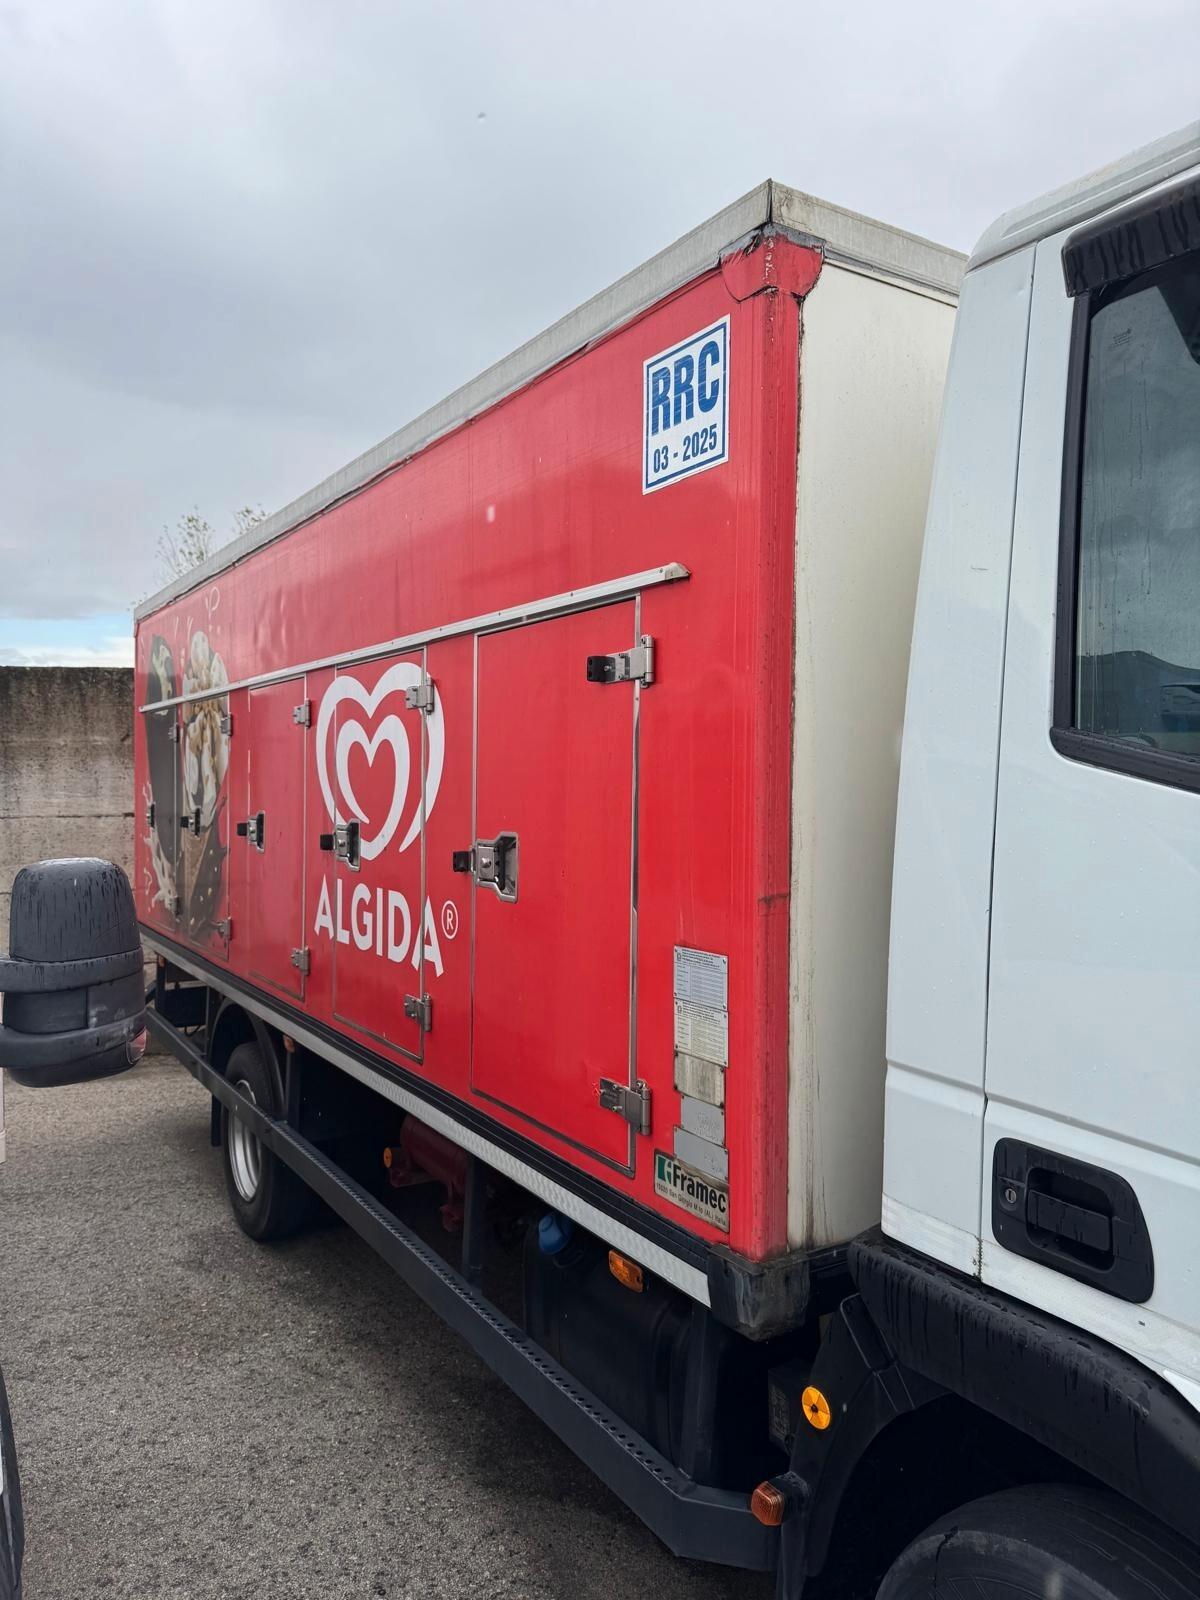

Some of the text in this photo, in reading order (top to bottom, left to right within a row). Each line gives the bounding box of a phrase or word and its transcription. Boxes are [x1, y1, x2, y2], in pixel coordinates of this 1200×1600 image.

[651, 340, 720, 436] RRC
[653, 445, 669, 474] 03
[682, 423, 718, 462] 2025
[672, 1164, 727, 1213] Framec
